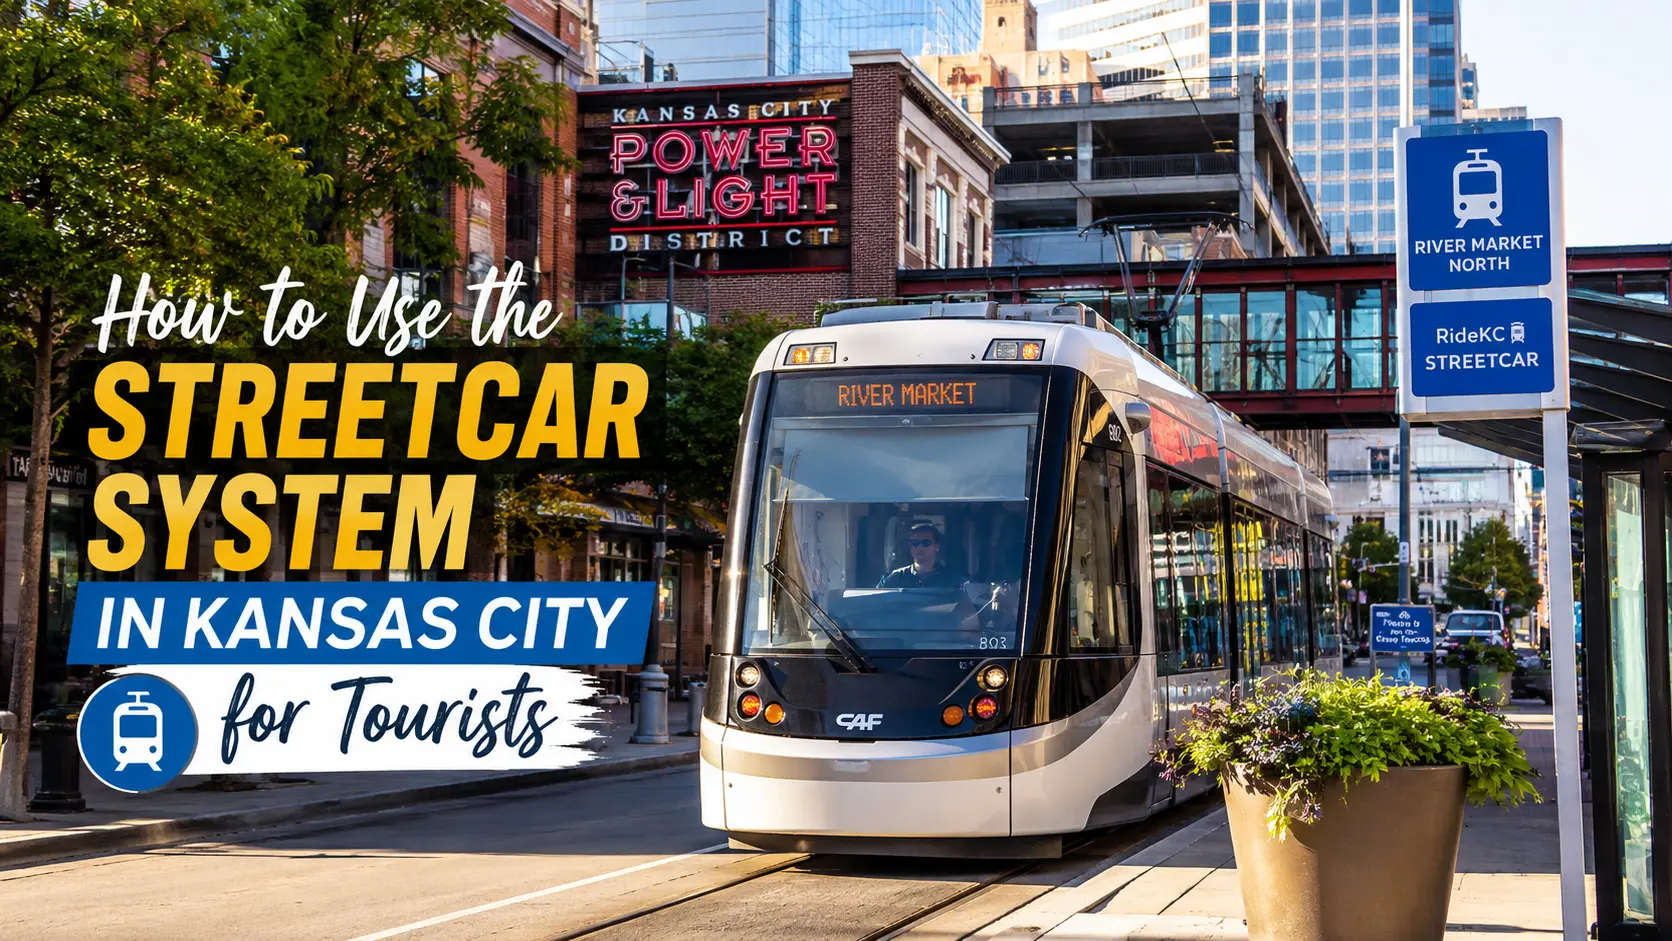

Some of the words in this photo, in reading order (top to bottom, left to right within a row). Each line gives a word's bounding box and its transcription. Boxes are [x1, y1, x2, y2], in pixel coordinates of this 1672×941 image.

[612, 103, 740, 123] KANSAS
[761, 99, 835, 117] CITY
[610, 125, 838, 175] POWER
[610, 227, 835, 252] DISTRICT
[1415, 238, 1467, 254] RIVER
[1471, 235, 1543, 252] MARKET
[1448, 256, 1510, 273] NORTH
[1435, 326, 1506, 344] RideKC
[1424, 351, 1540, 371] STREETCAR
[838, 383, 895, 407] RIVER
[901, 382, 978, 406] MARKET
[836, 713, 884, 731] CAF
